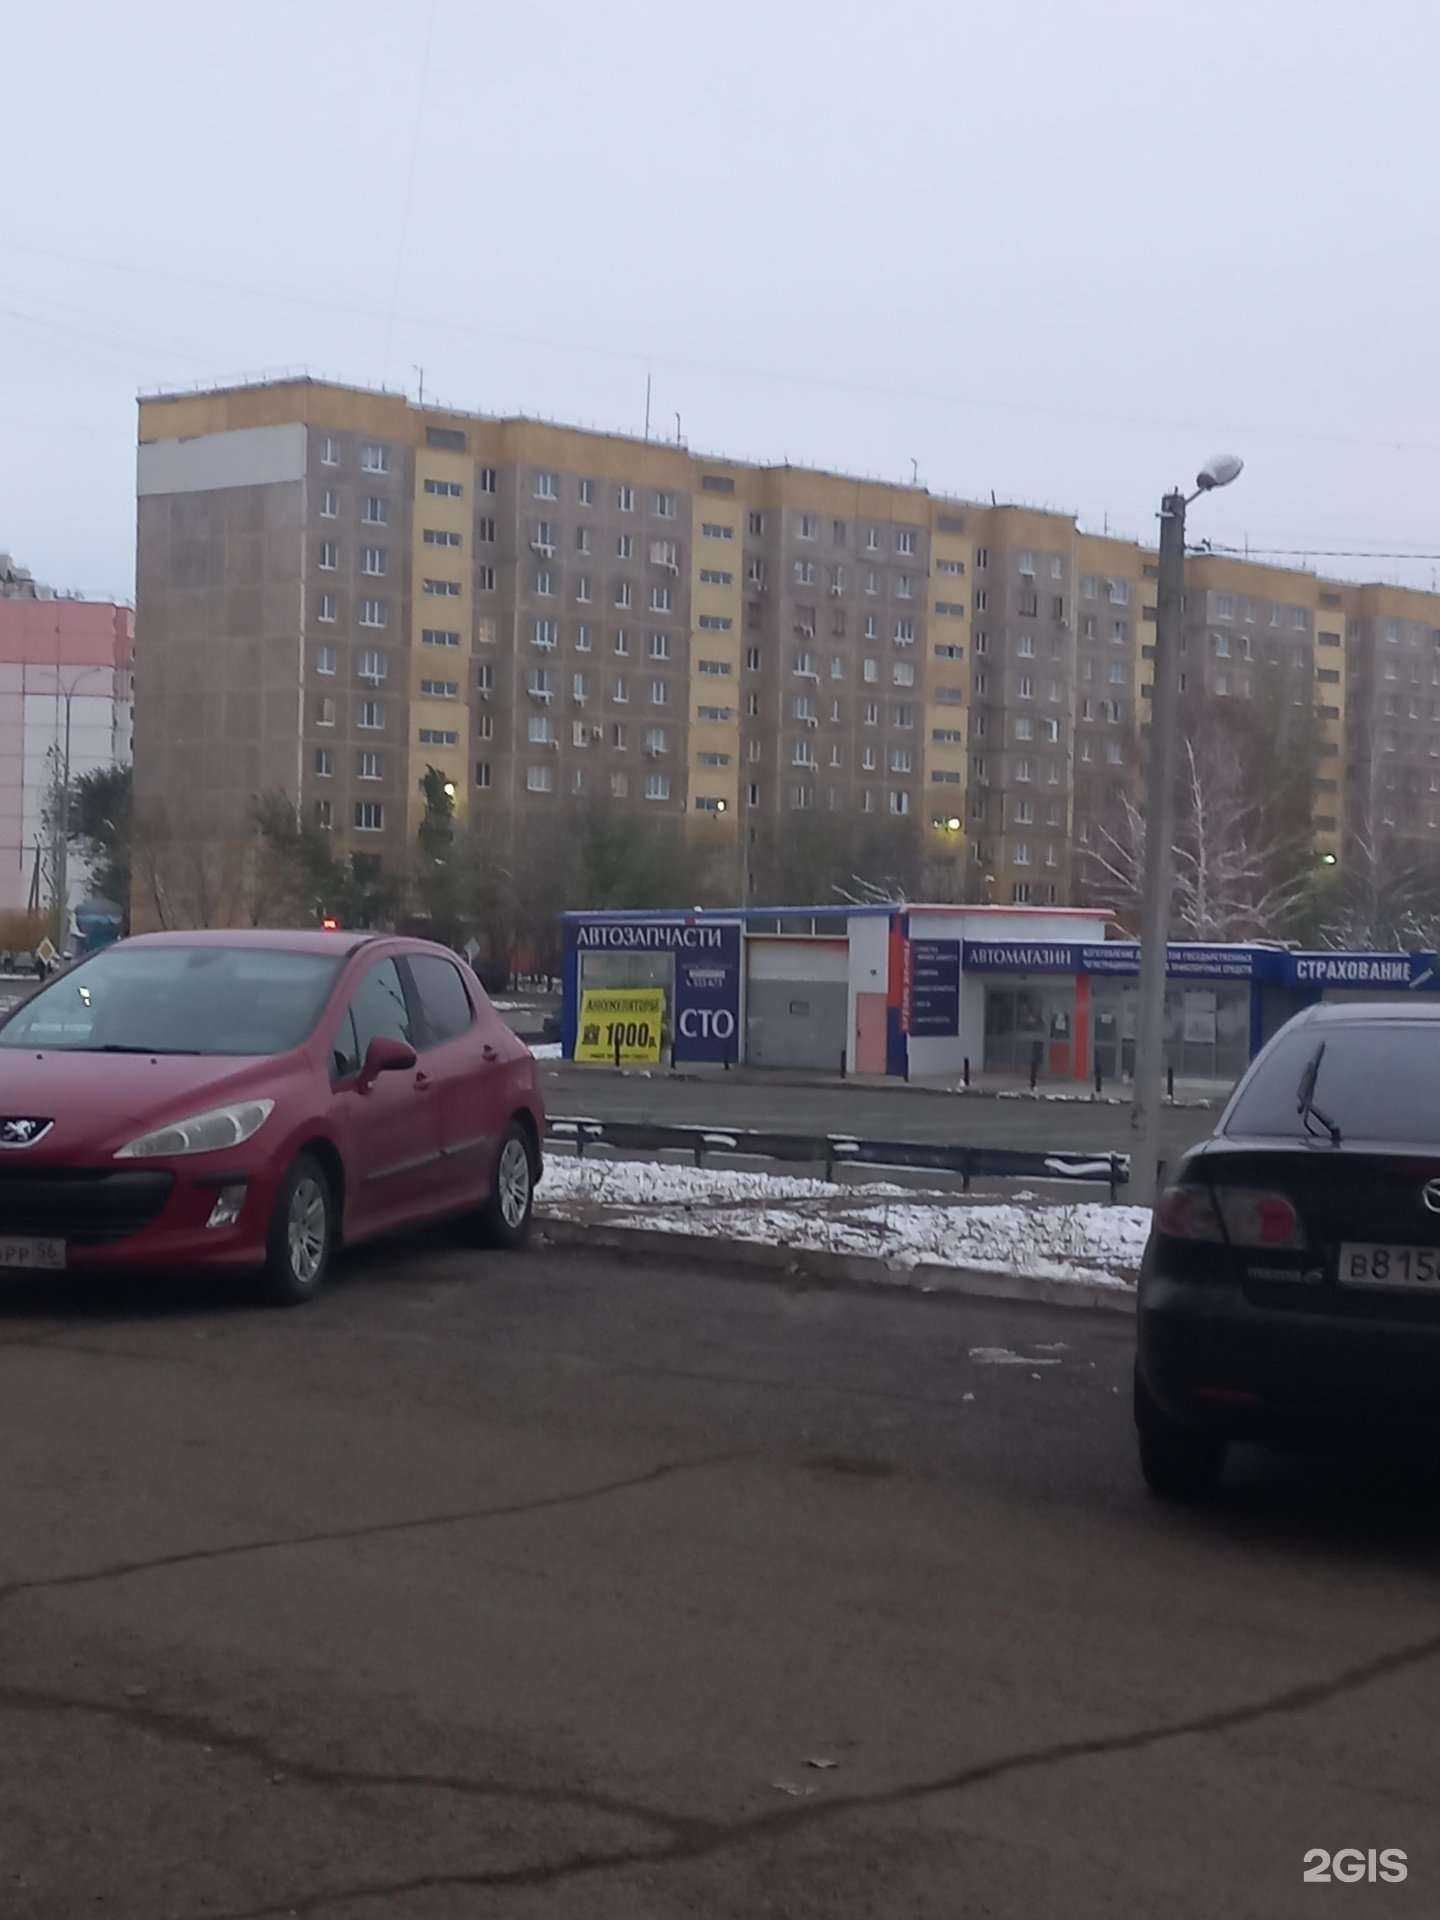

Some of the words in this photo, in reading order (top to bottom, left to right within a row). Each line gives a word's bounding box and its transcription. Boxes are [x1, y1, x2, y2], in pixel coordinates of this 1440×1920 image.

[576, 926, 722, 948] АВТОЗАПЧАСТИ
[969, 948, 1072, 966] АВТОМАГАЗИН
[1296, 960, 1411, 982] СТРАХОВАНИЕ
[679, 1008, 735, 1039] СТО
[1350, 1248, 1440, 1282] В815
